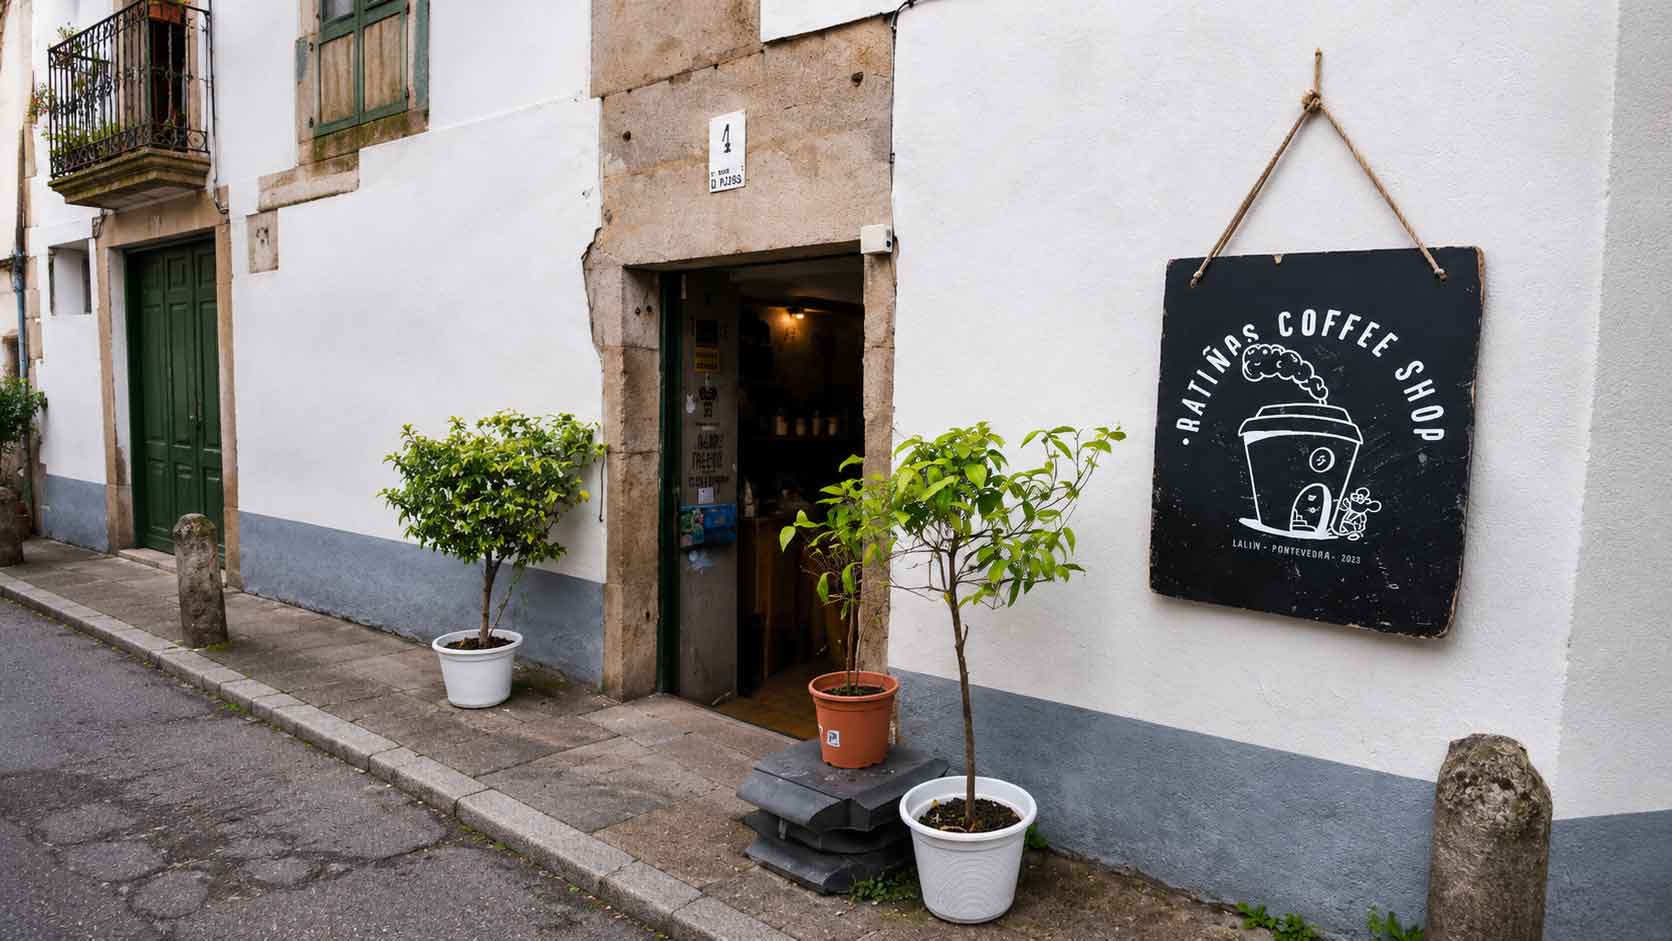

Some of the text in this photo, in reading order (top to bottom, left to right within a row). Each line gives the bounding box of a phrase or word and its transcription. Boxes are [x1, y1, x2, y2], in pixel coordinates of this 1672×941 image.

[1176, 308, 1445, 441] RATIÑAS COFFEE SHOP
[1271, 544, 1331, 561] PONTEVEDRA
[1341, 553, 1361, 565] 2023
